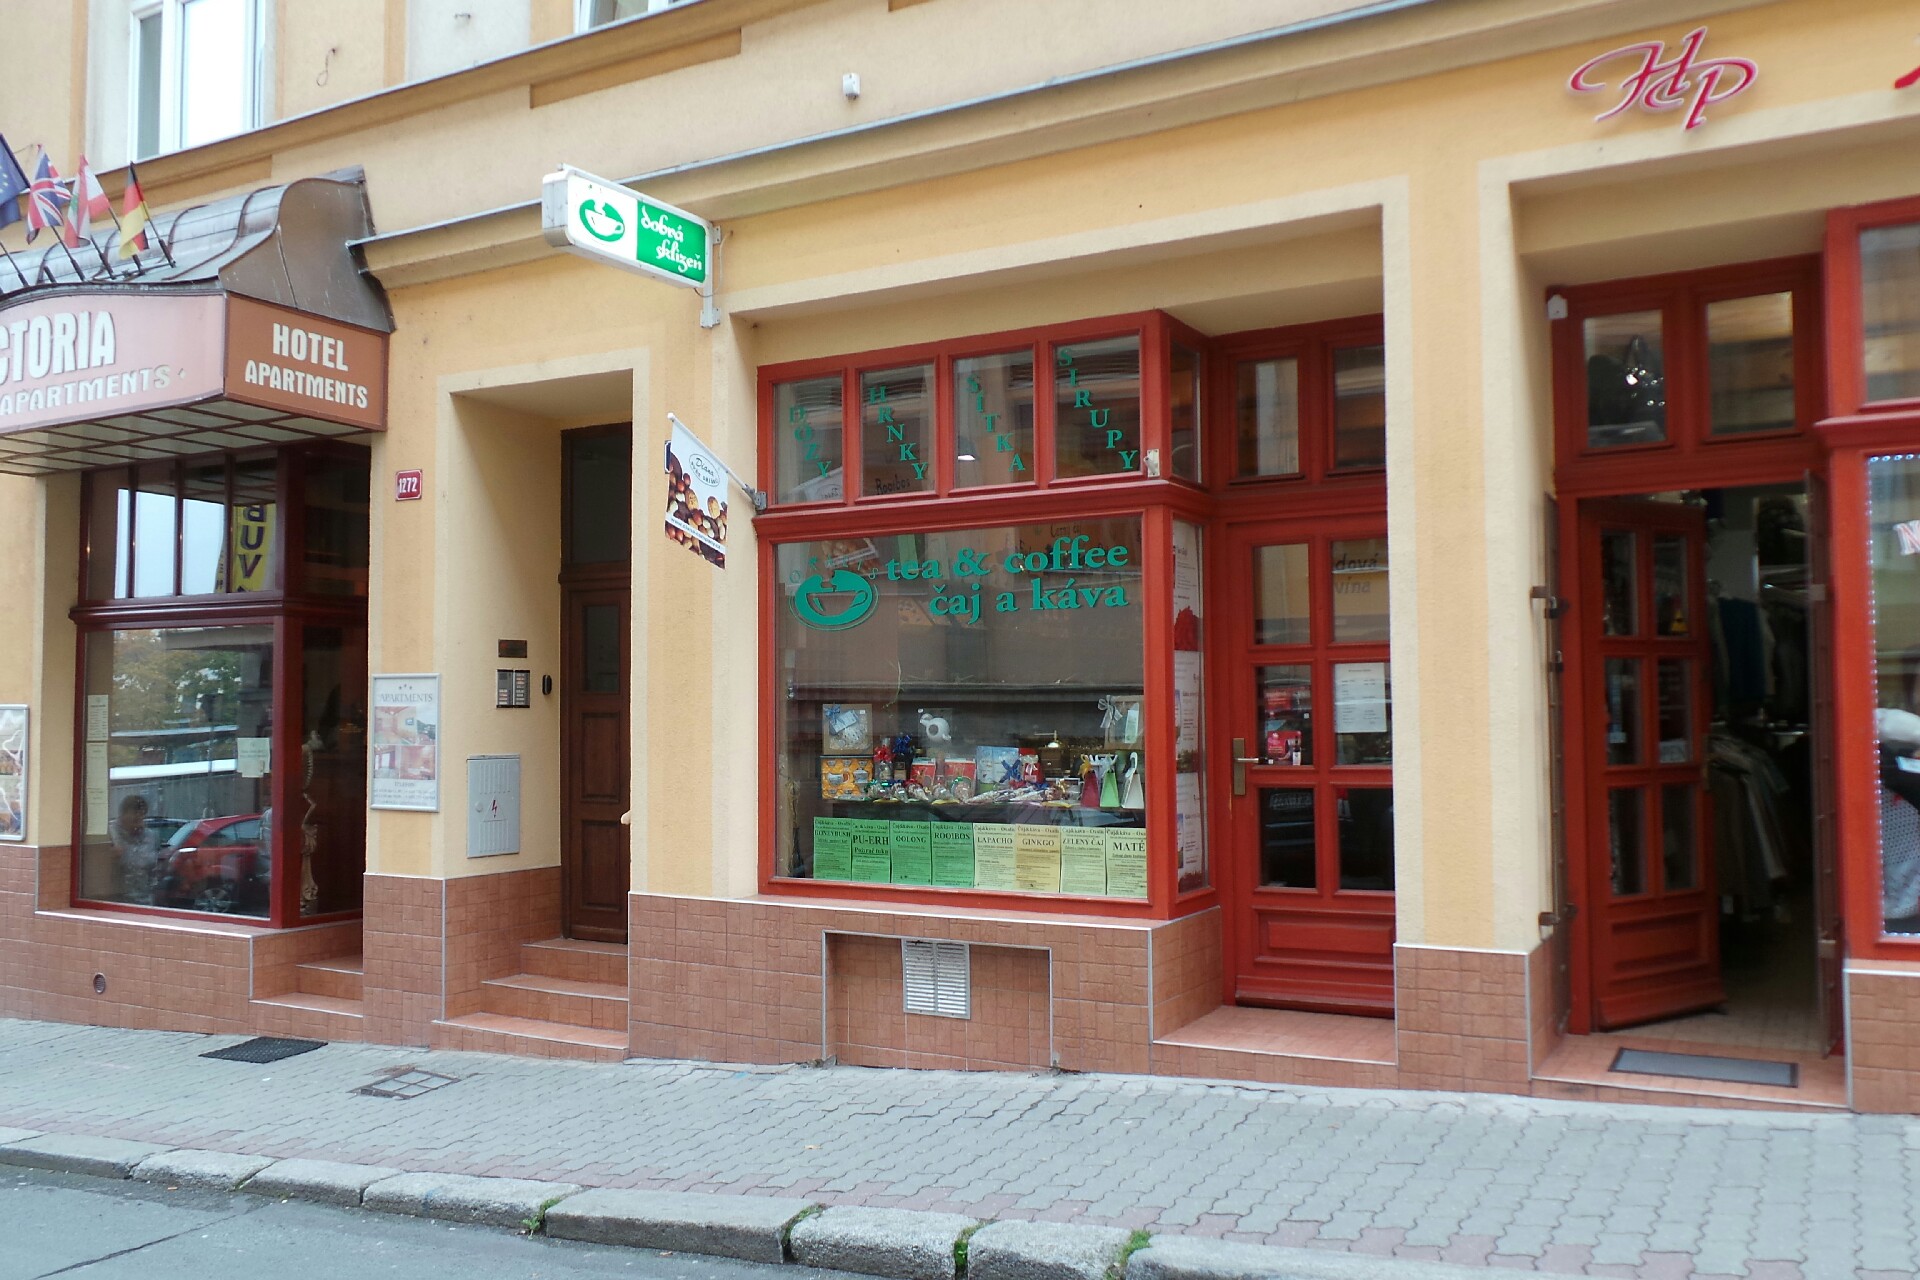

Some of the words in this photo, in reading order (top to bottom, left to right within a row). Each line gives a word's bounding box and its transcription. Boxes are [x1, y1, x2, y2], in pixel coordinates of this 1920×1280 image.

[273, 323, 349, 371] HOTEL
[245, 360, 368, 410] APARTMENTS
[1058, 348, 1138, 469] SIRUPY
[868, 386, 928, 480] HRNKY
[399, 477, 417, 493] 1272
[875, 474, 911, 496] Rooibos
[886, 557, 943, 581] tea
[953, 546, 991, 577] &
[1004, 535, 1128, 574] coffee
[929, 583, 980, 625] čaj
[995, 592, 1019, 613] a
[1030, 577, 1129, 611] káva
[380, 693, 433, 703] APARTMENTS
[853, 834, 889, 846] PU-ERH
[895, 835, 926, 844] OOLONG
[934, 832, 970, 840] ROOIBOS
[977, 836, 1013, 845] LAPACHO
[1022, 838, 1055, 847] GINKGO
[1113, 840, 1145, 852] MATÉ
